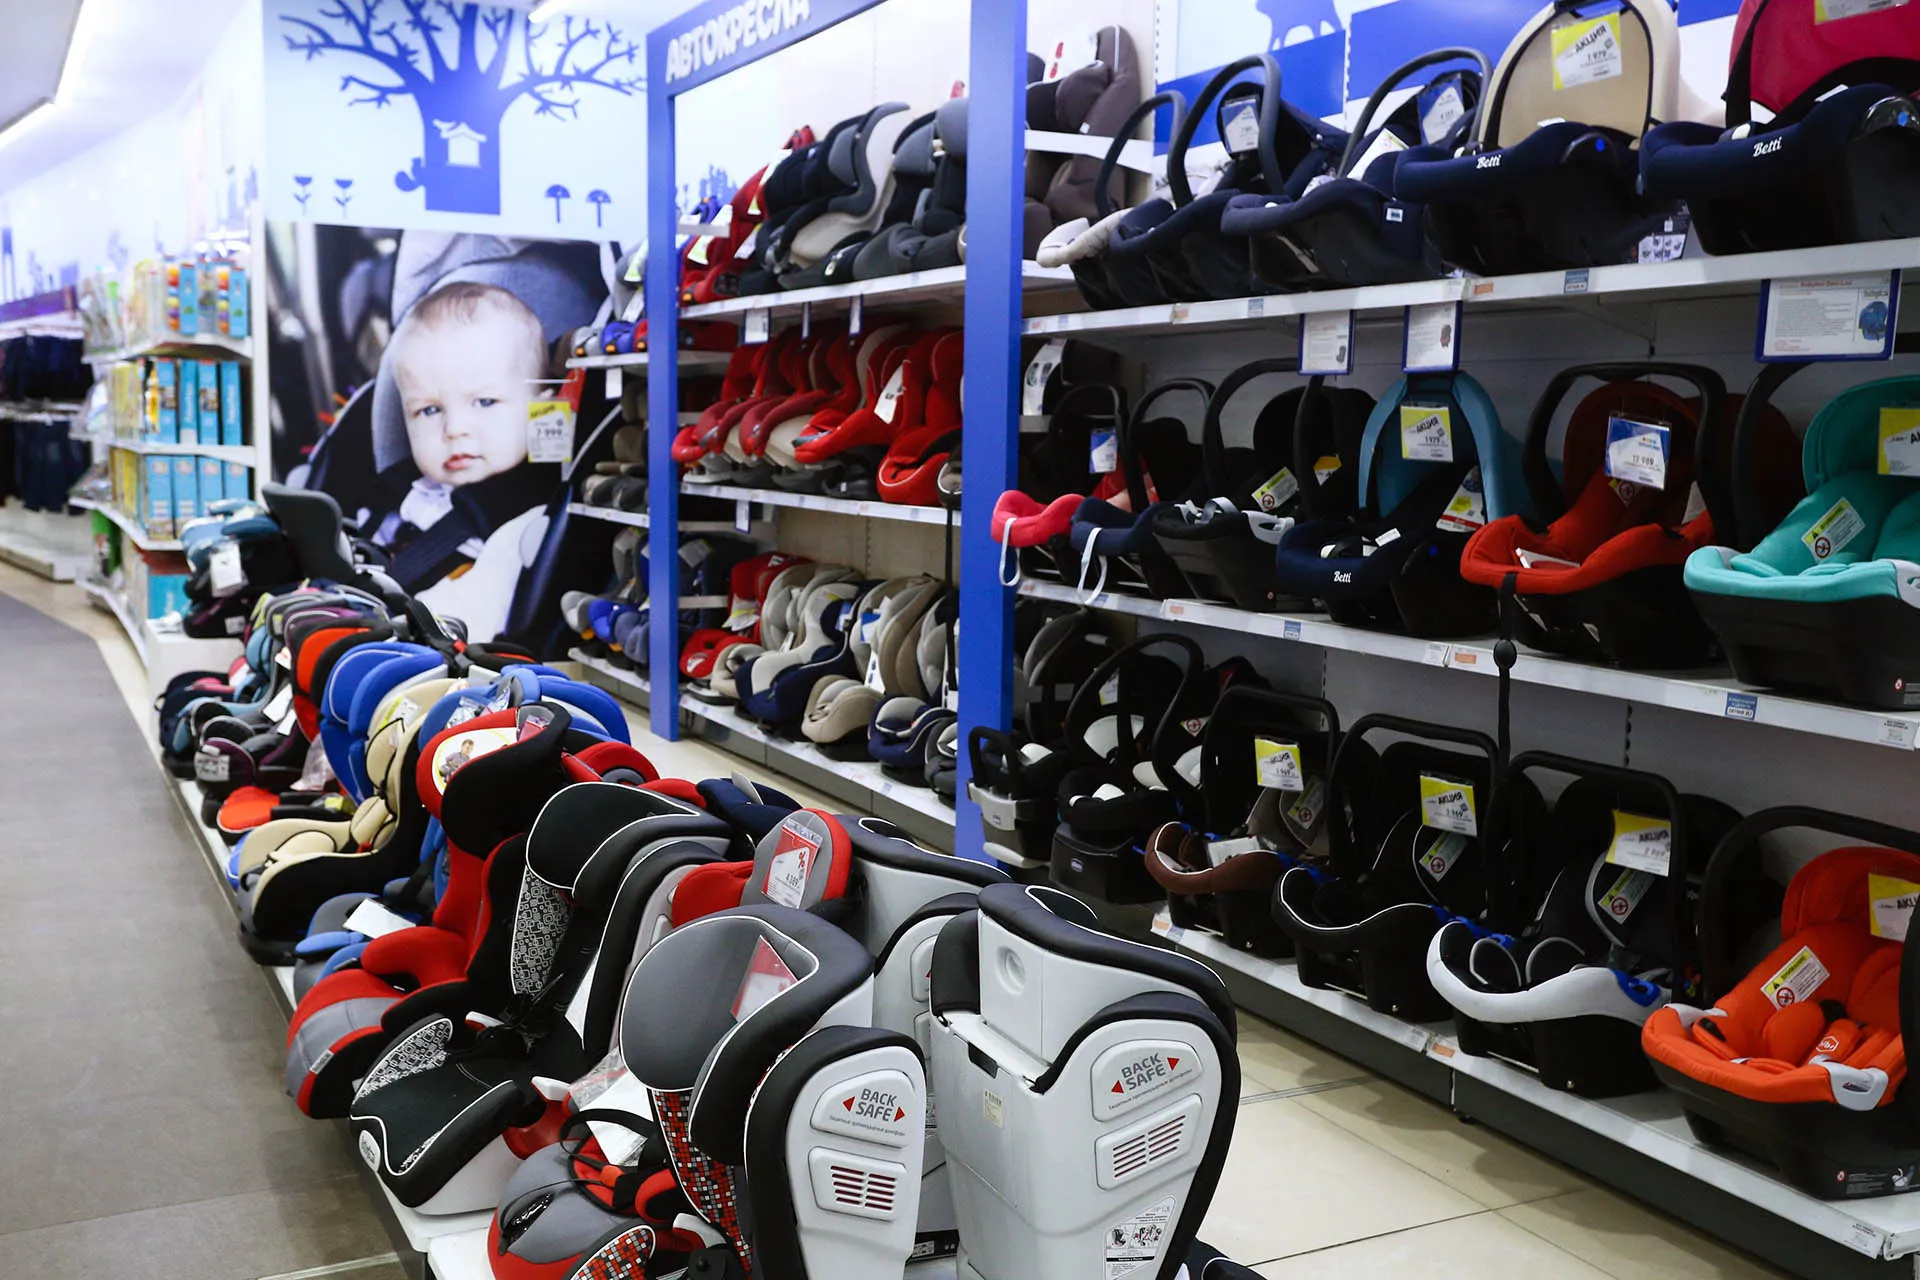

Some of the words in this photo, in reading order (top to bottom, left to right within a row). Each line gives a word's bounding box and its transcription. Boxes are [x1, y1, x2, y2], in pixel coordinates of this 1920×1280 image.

[665, 0, 811, 84] АВТОКРЕСЛА
[1575, 24, 1607, 53] АКЦИЯ
[1753, 136, 1782, 157] Betti
[1476, 154, 1502, 169] Betti
[1416, 416, 1440, 433] АКЦИЯ
[1333, 570, 1352, 583] Betti
[1121, 1052, 1161, 1079] BACK
[1125, 1063, 1166, 1090] SAFE
[861, 1088, 897, 1107] BACK
[855, 1101, 893, 1122] SAFE
